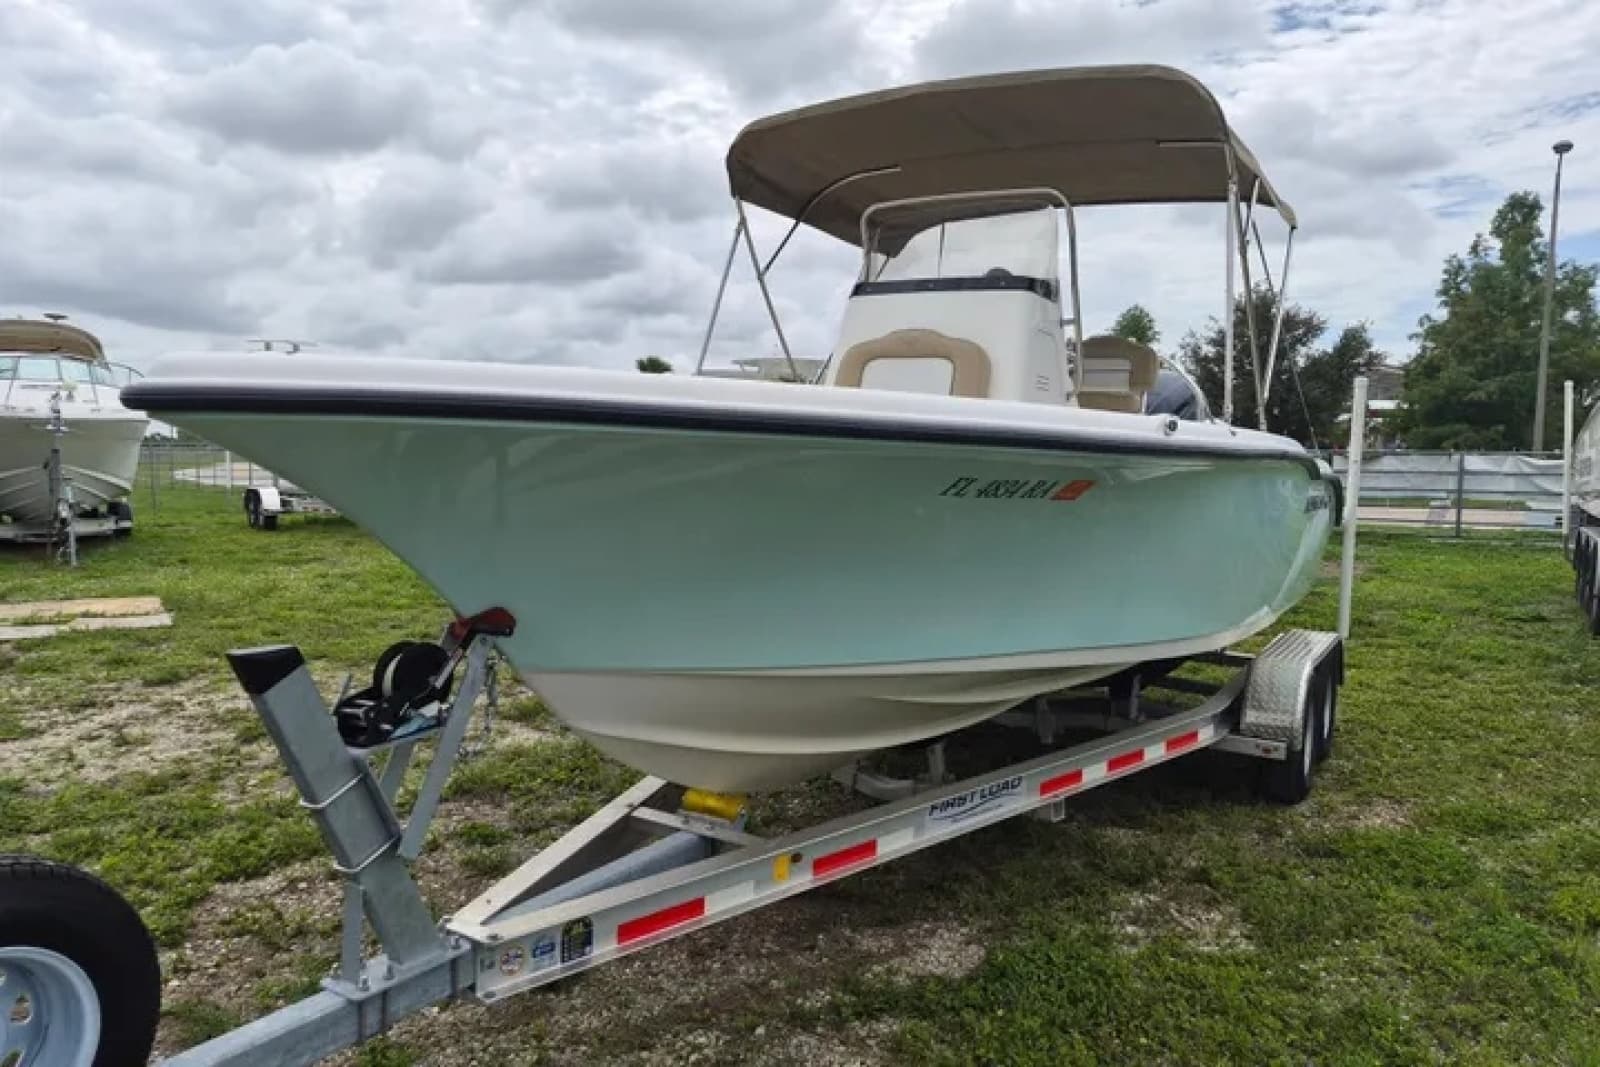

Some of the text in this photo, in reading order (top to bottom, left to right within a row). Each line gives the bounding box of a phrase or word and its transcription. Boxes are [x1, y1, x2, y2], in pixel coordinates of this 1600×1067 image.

[938, 477, 978, 498] FL
[928, 790, 976, 816] FIRST
[979, 775, 1022, 799] LOAD
